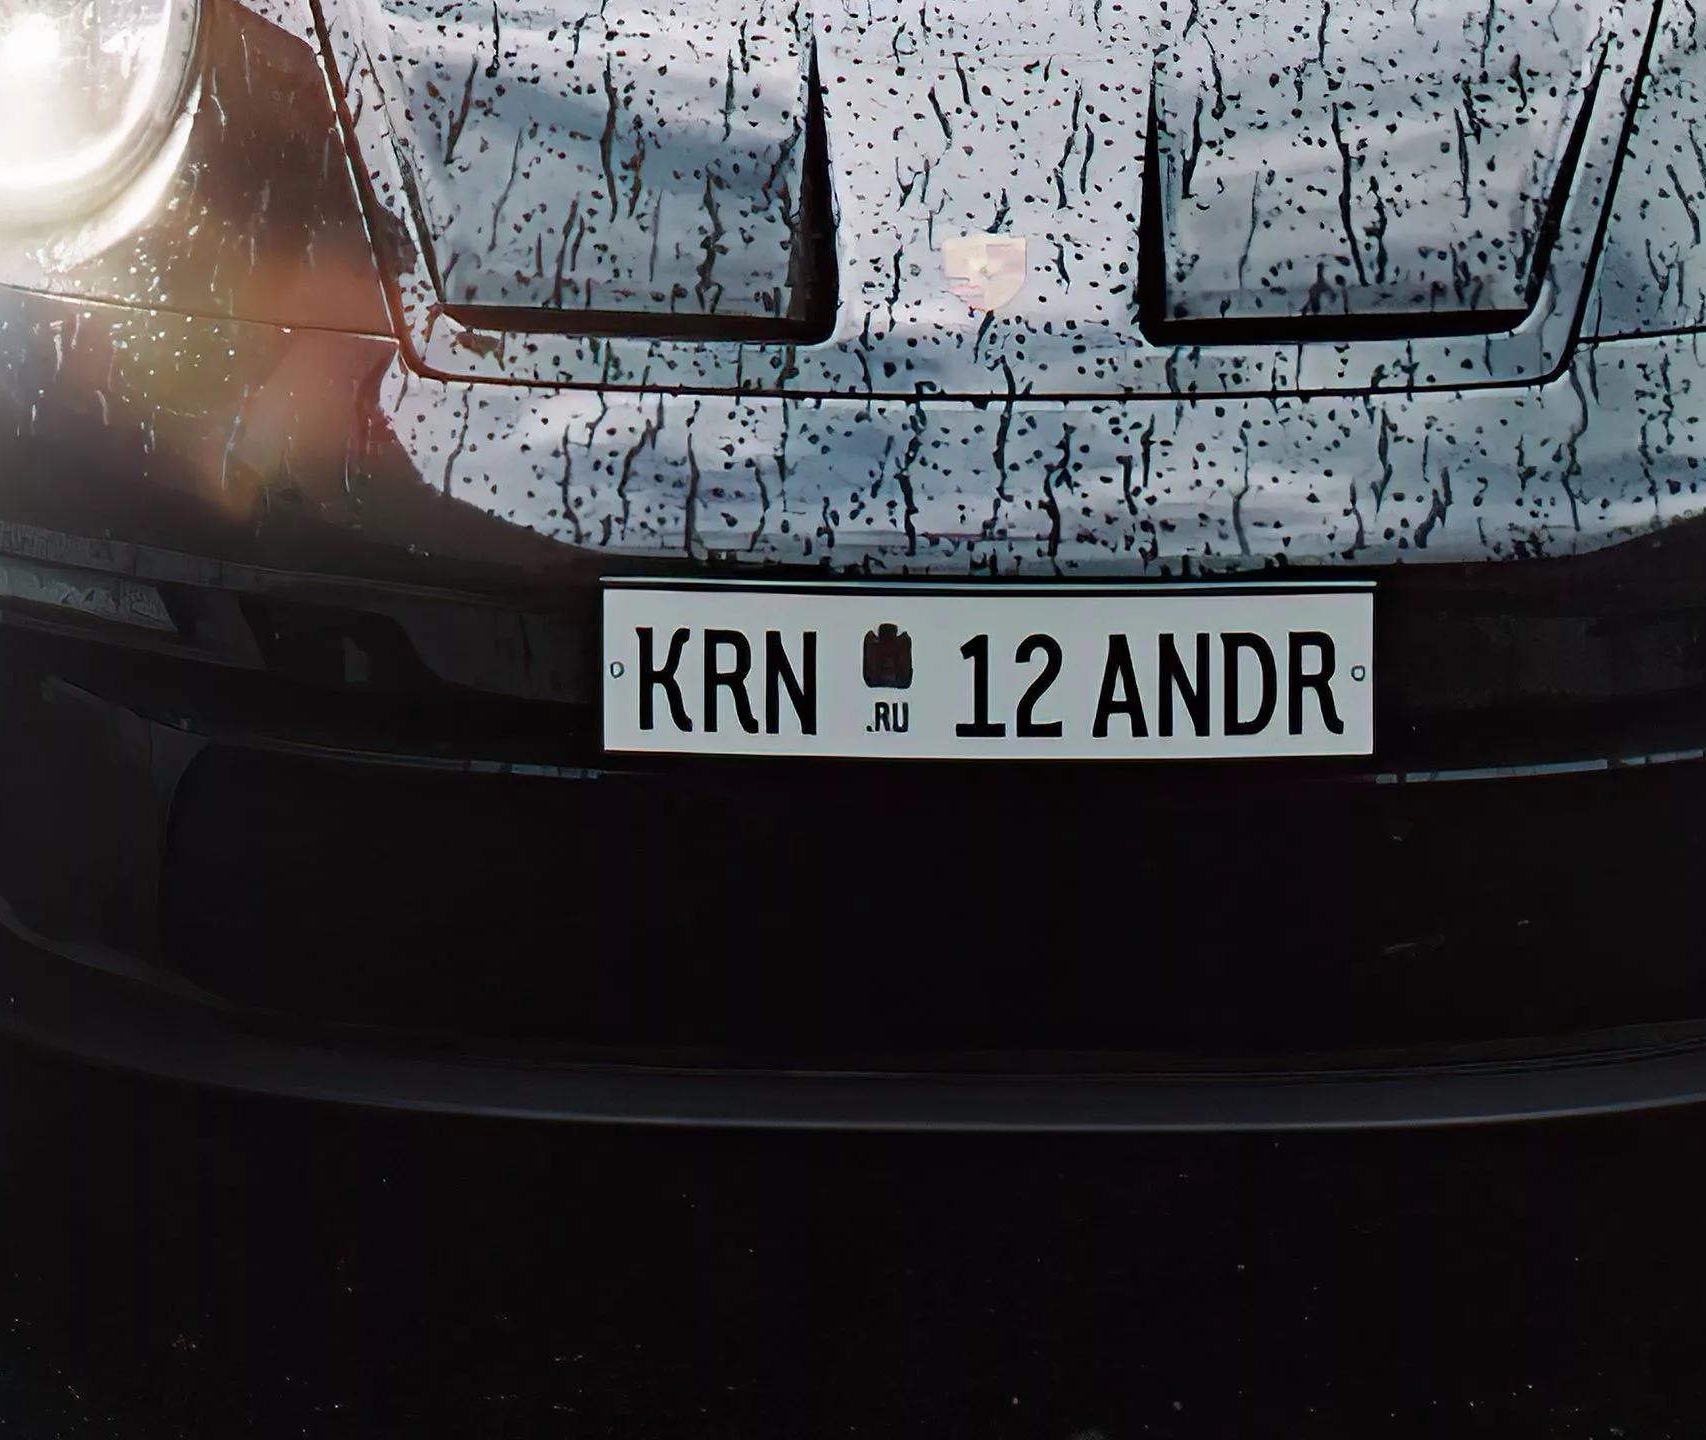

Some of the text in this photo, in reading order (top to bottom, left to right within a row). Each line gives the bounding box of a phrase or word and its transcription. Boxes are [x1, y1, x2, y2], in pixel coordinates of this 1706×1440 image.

[635, 626, 1346, 738] KRN 12 ANDR
[865, 701, 910, 733] .RU
